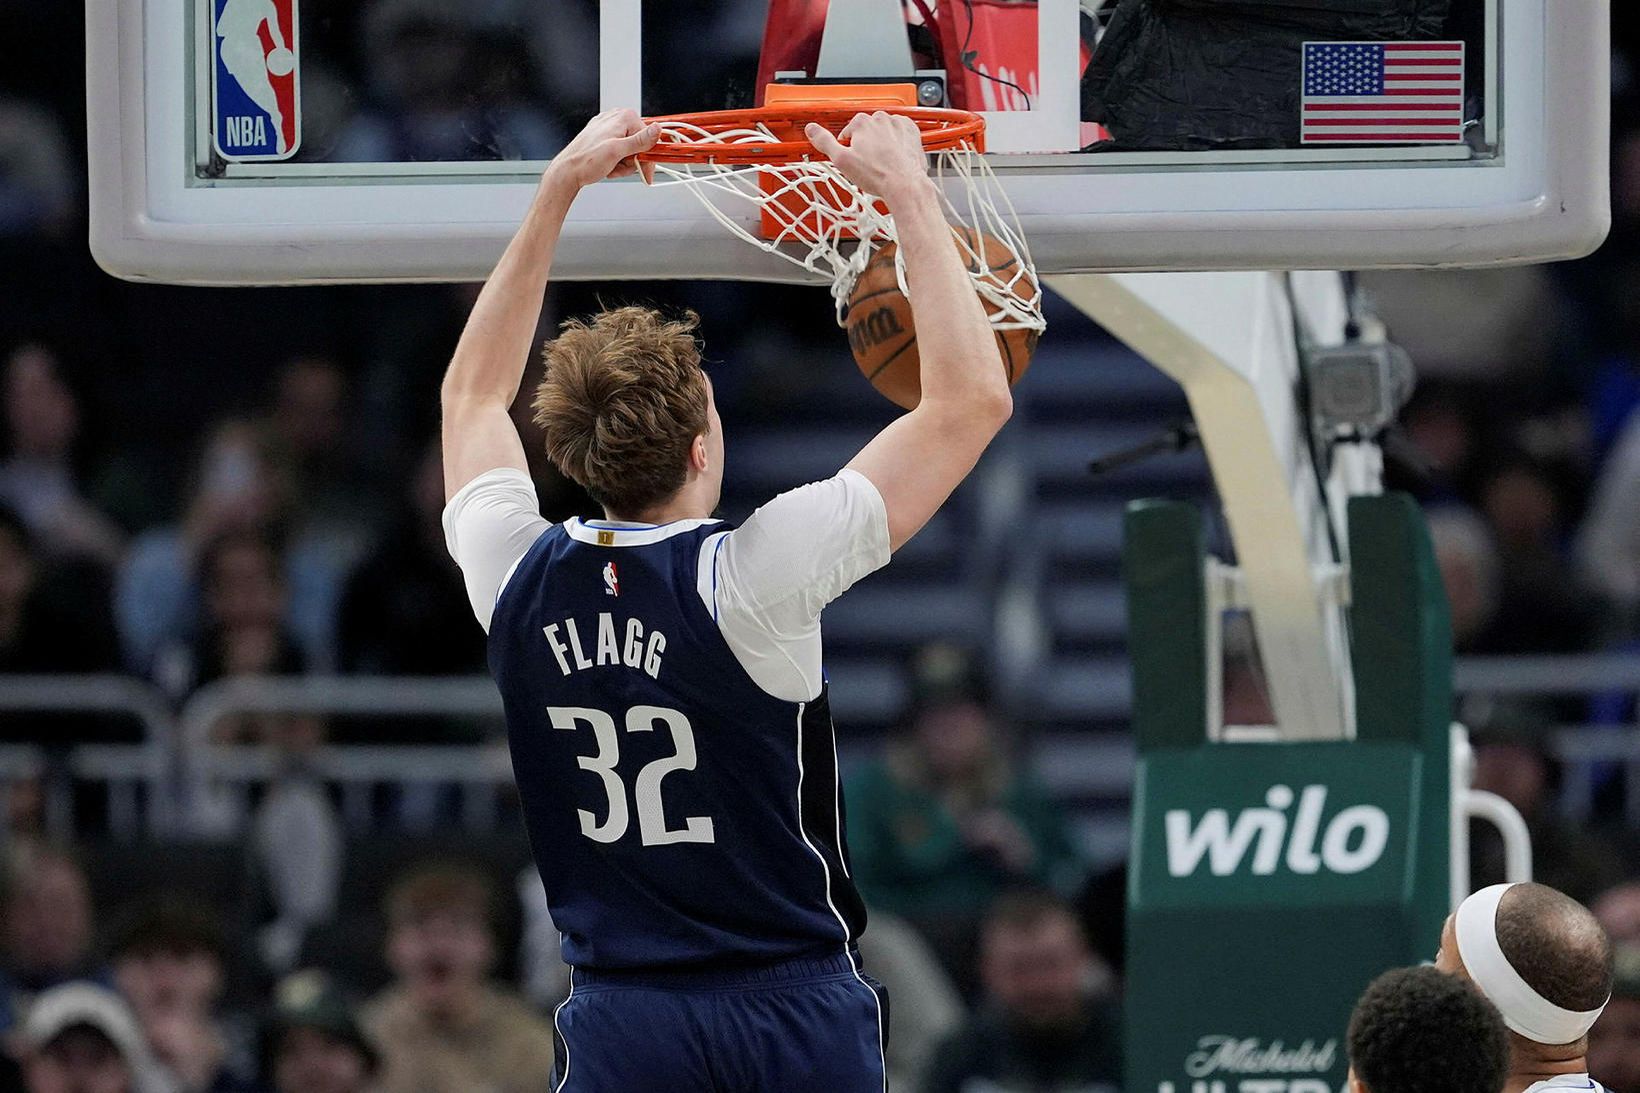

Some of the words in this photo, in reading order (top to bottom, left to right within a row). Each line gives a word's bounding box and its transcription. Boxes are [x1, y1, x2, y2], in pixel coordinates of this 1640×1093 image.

[226, 116, 267, 147] NBA
[543, 612, 667, 680] FLAGG
[546, 705, 715, 847] 32
[1165, 784, 1390, 877] wilo
